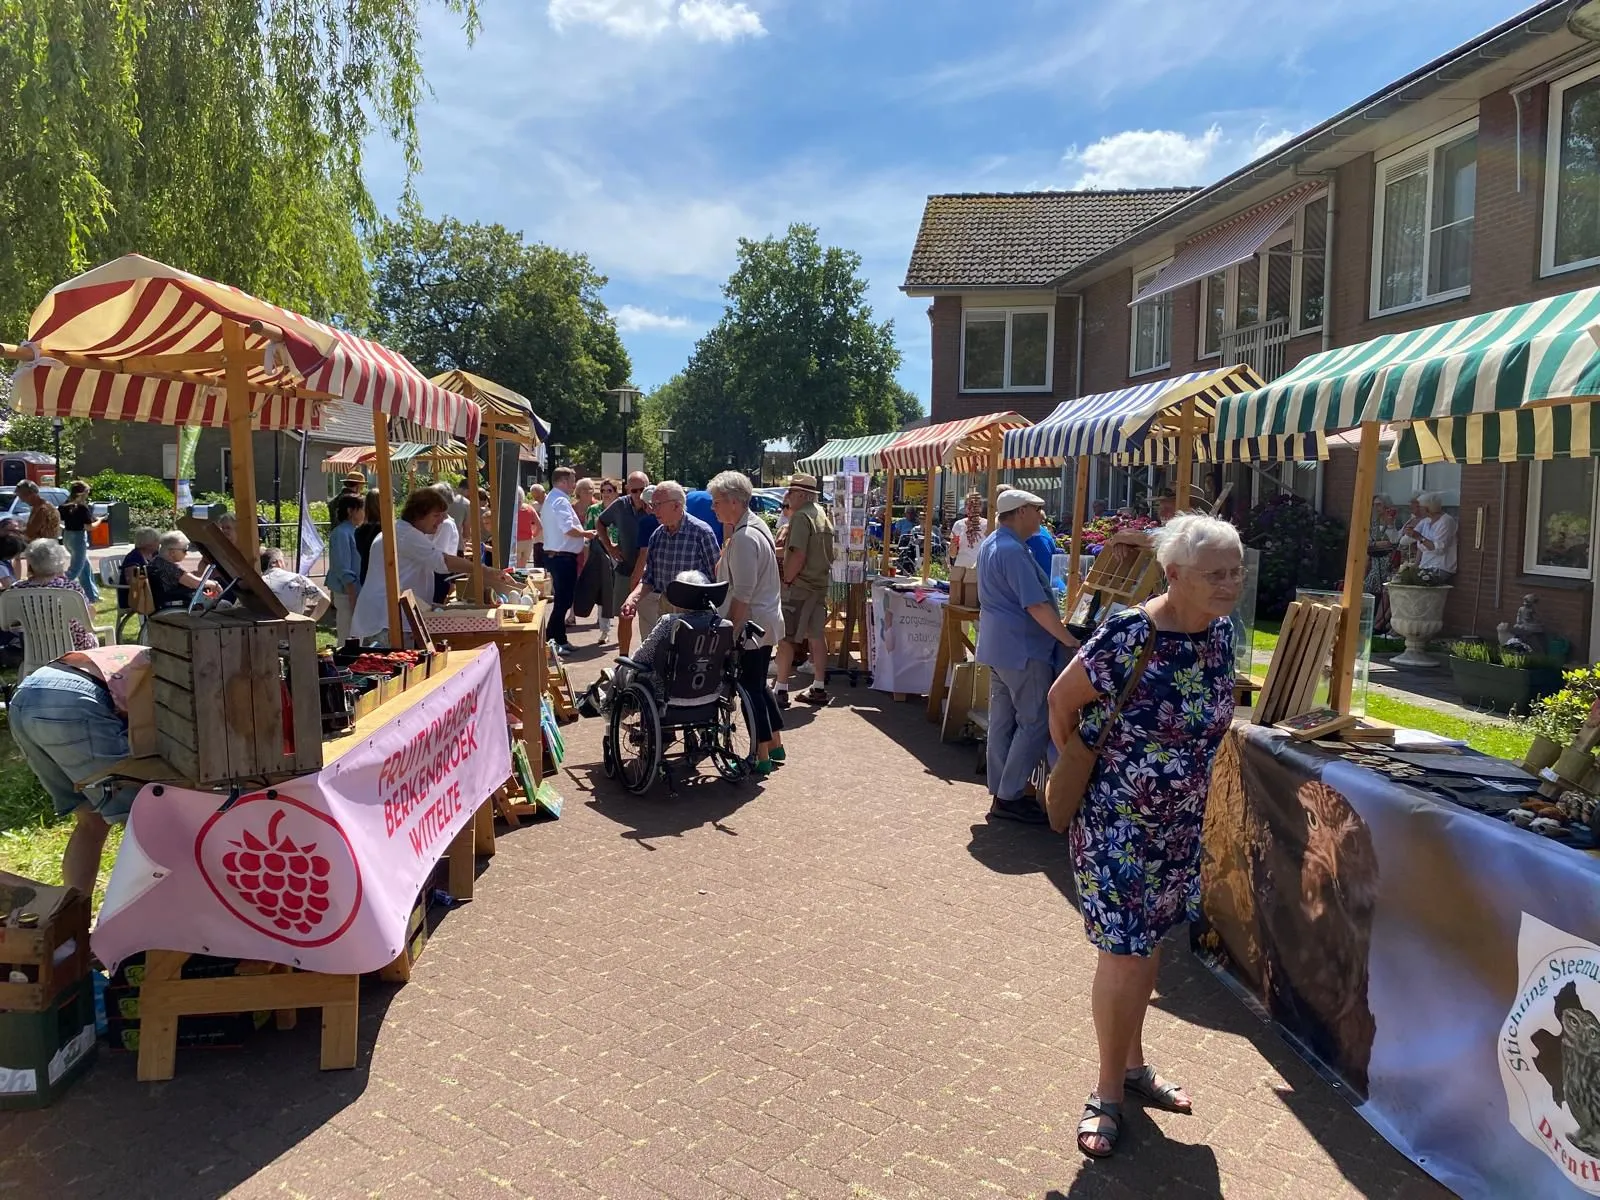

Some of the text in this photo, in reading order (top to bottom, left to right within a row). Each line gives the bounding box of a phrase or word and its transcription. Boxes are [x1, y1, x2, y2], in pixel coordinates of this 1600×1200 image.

[379, 683, 480, 797] FRUITKWEKERIJ
[384, 721, 478, 839] BERKENBROEK
[409, 780, 462, 858] WITTELTE
[1502, 958, 1600, 1073] Stichting Steenu
